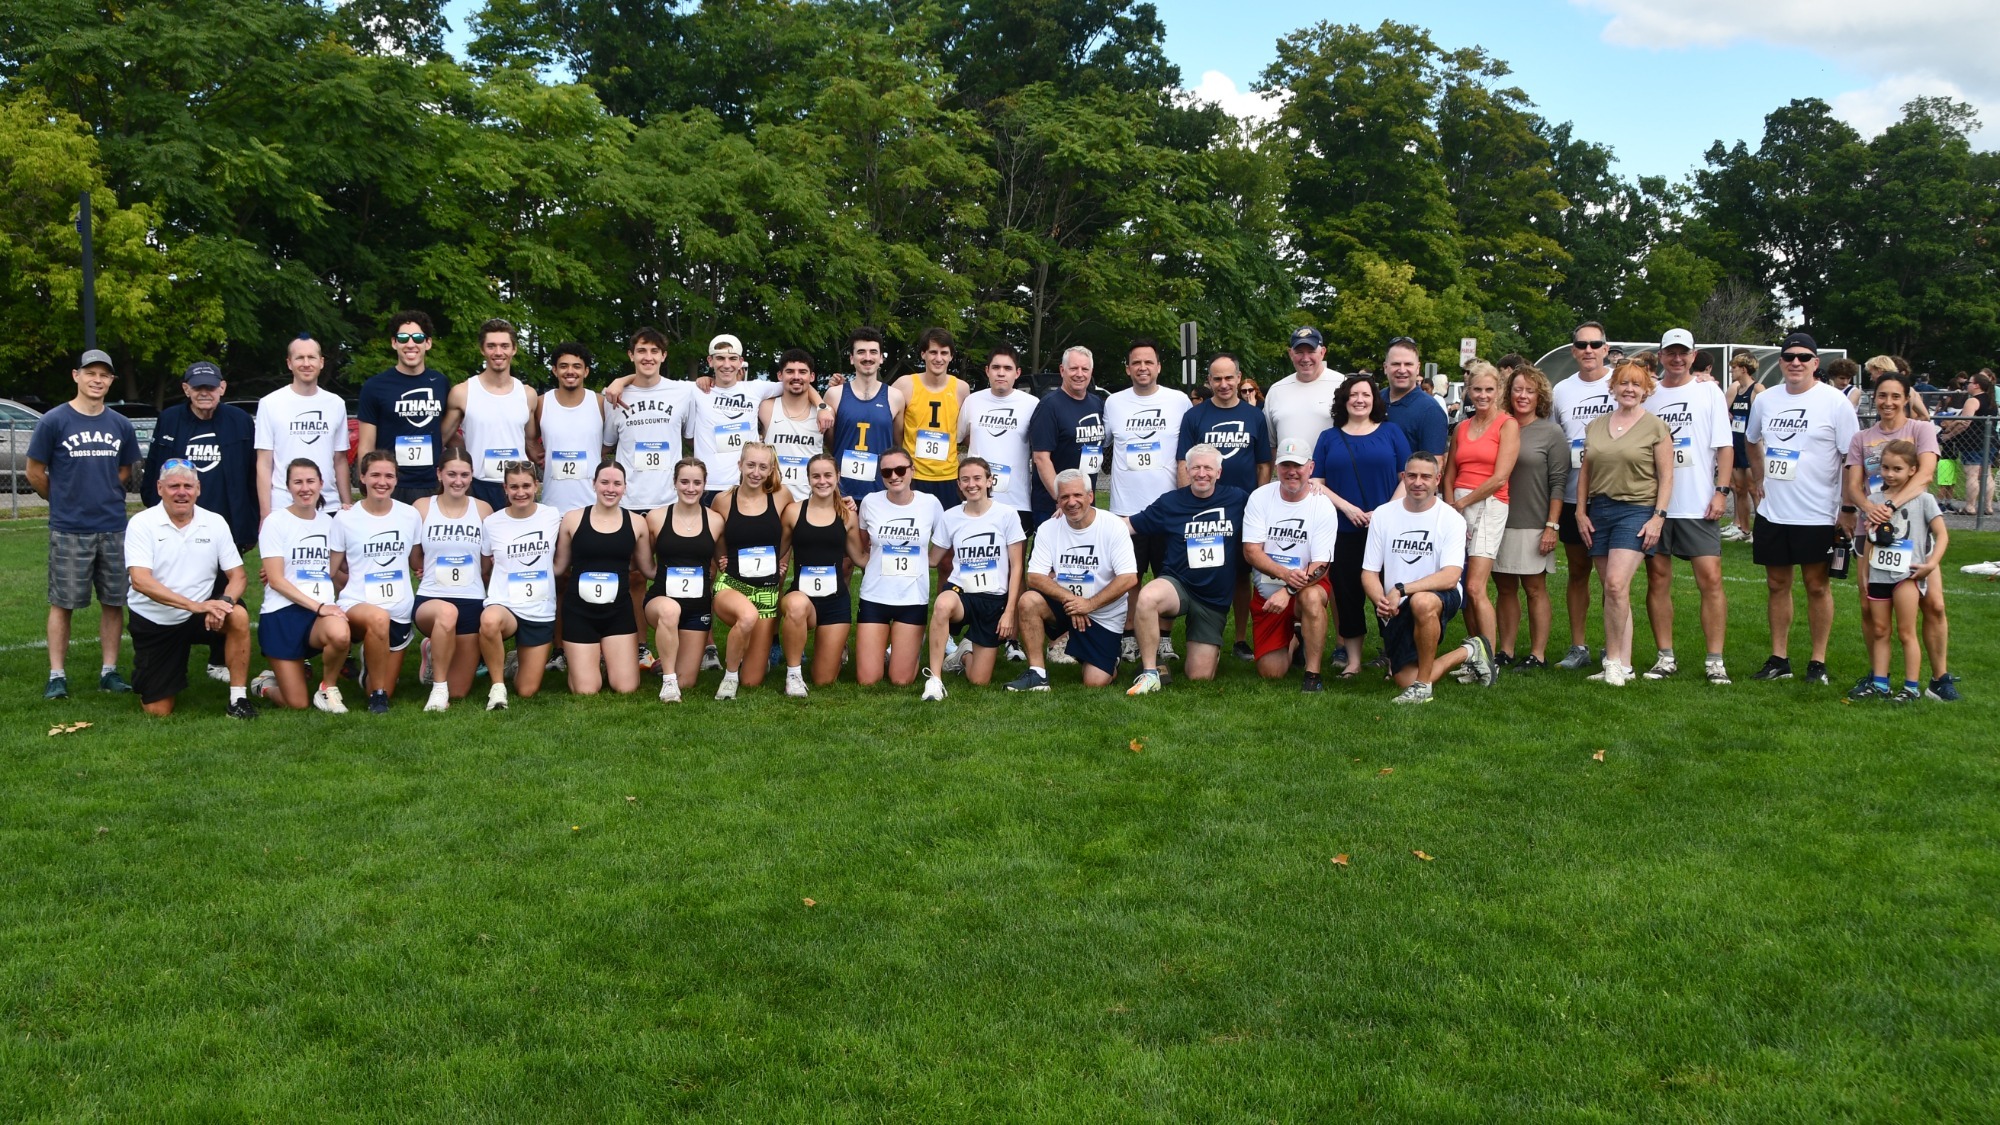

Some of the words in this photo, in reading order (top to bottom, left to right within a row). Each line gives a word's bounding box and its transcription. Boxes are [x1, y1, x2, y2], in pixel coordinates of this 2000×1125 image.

[395, 400, 442, 412] ITHACA
[714, 396, 753, 408] ITHACA
[622, 400, 673, 419] ITHACA
[928, 401, 941, 428] I
[1573, 405, 1614, 416] ITHACA
[979, 415, 1017, 426] ITHACA
[1126, 418, 1166, 427] ITHACA
[1656, 413, 1692, 422] THACA
[1769, 418, 1808, 430] ITHACA
[290, 422, 328, 430] ITHACA
[1076, 426, 1104, 438] ITHAC
[62, 431, 121, 450] ITHACA
[728, 434, 741, 447] 46
[774, 434, 815, 445] ITHACA
[854, 422, 870, 451] I
[1205, 432, 1250, 443] ITHACA
[185, 445, 221, 456] THAC
[408, 447, 422, 460] 37
[926, 441, 939, 454] 36
[646, 453, 660, 466] 38
[1089, 456, 1098, 468] 43
[1138, 453, 1150, 466] 39
[496, 460, 503, 473] 4
[562, 462, 576, 475] 42
[852, 462, 865, 475] 31
[1769, 461, 1787, 474] 879
[785, 467, 798, 480] 41
[992, 474, 998, 486] 5
[428, 524, 482, 538] ITHACA
[878, 526, 920, 537] ITHACA
[1184, 520, 1233, 533] ITHACA
[1268, 527, 1307, 540] ITHACA
[364, 542, 405, 553] ITHACA
[507, 540, 550, 554] ITHACA
[1392, 539, 1433, 551] ITHACA
[292, 547, 330, 559] ITHAC
[958, 546, 1000, 558] ITHACA
[1200, 548, 1214, 562] 34
[1878, 550, 1901, 566] 889
[754, 558, 761, 571] 7
[895, 558, 908, 570] 13
[1060, 554, 1099, 565] ITHACA
[452, 568, 459, 581] 8
[974, 573, 986, 586] 11
[313, 582, 320, 596] 4
[380, 584, 394, 597] 10
[526, 584, 533, 597] 3
[595, 584, 602, 597] 9
[682, 579, 688, 592] 2
[814, 578, 821, 591] 6
[1069, 585, 1083, 596] 33
